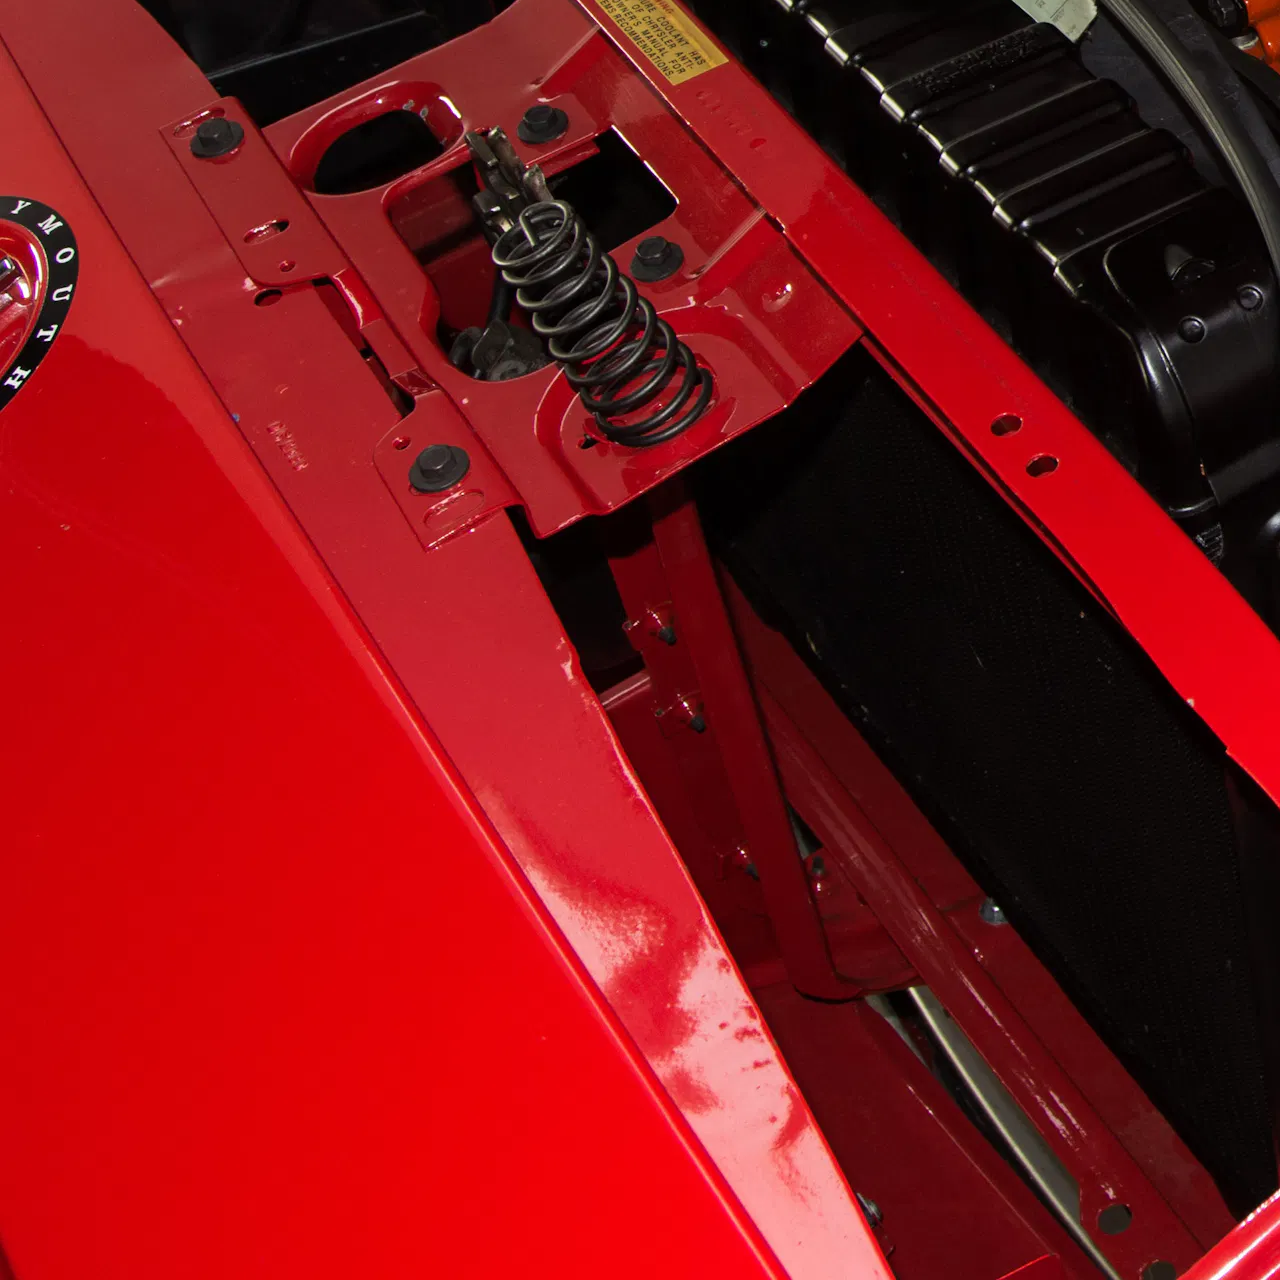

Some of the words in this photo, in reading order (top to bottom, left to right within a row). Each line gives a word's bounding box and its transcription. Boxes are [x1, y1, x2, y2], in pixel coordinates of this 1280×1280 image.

[612, 14, 676, 77] RECOMMENDATIONS.
[630, 4, 644, 13] OF
[641, 15, 677, 48] CHRYSLER
[673, 50, 696, 69] ANTI-
[639, 28, 669, 55] MANUAL
[668, 59, 686, 73] FOR
[655, 16, 689, 47] COOLANT
[687, 50, 705, 64] HAS
